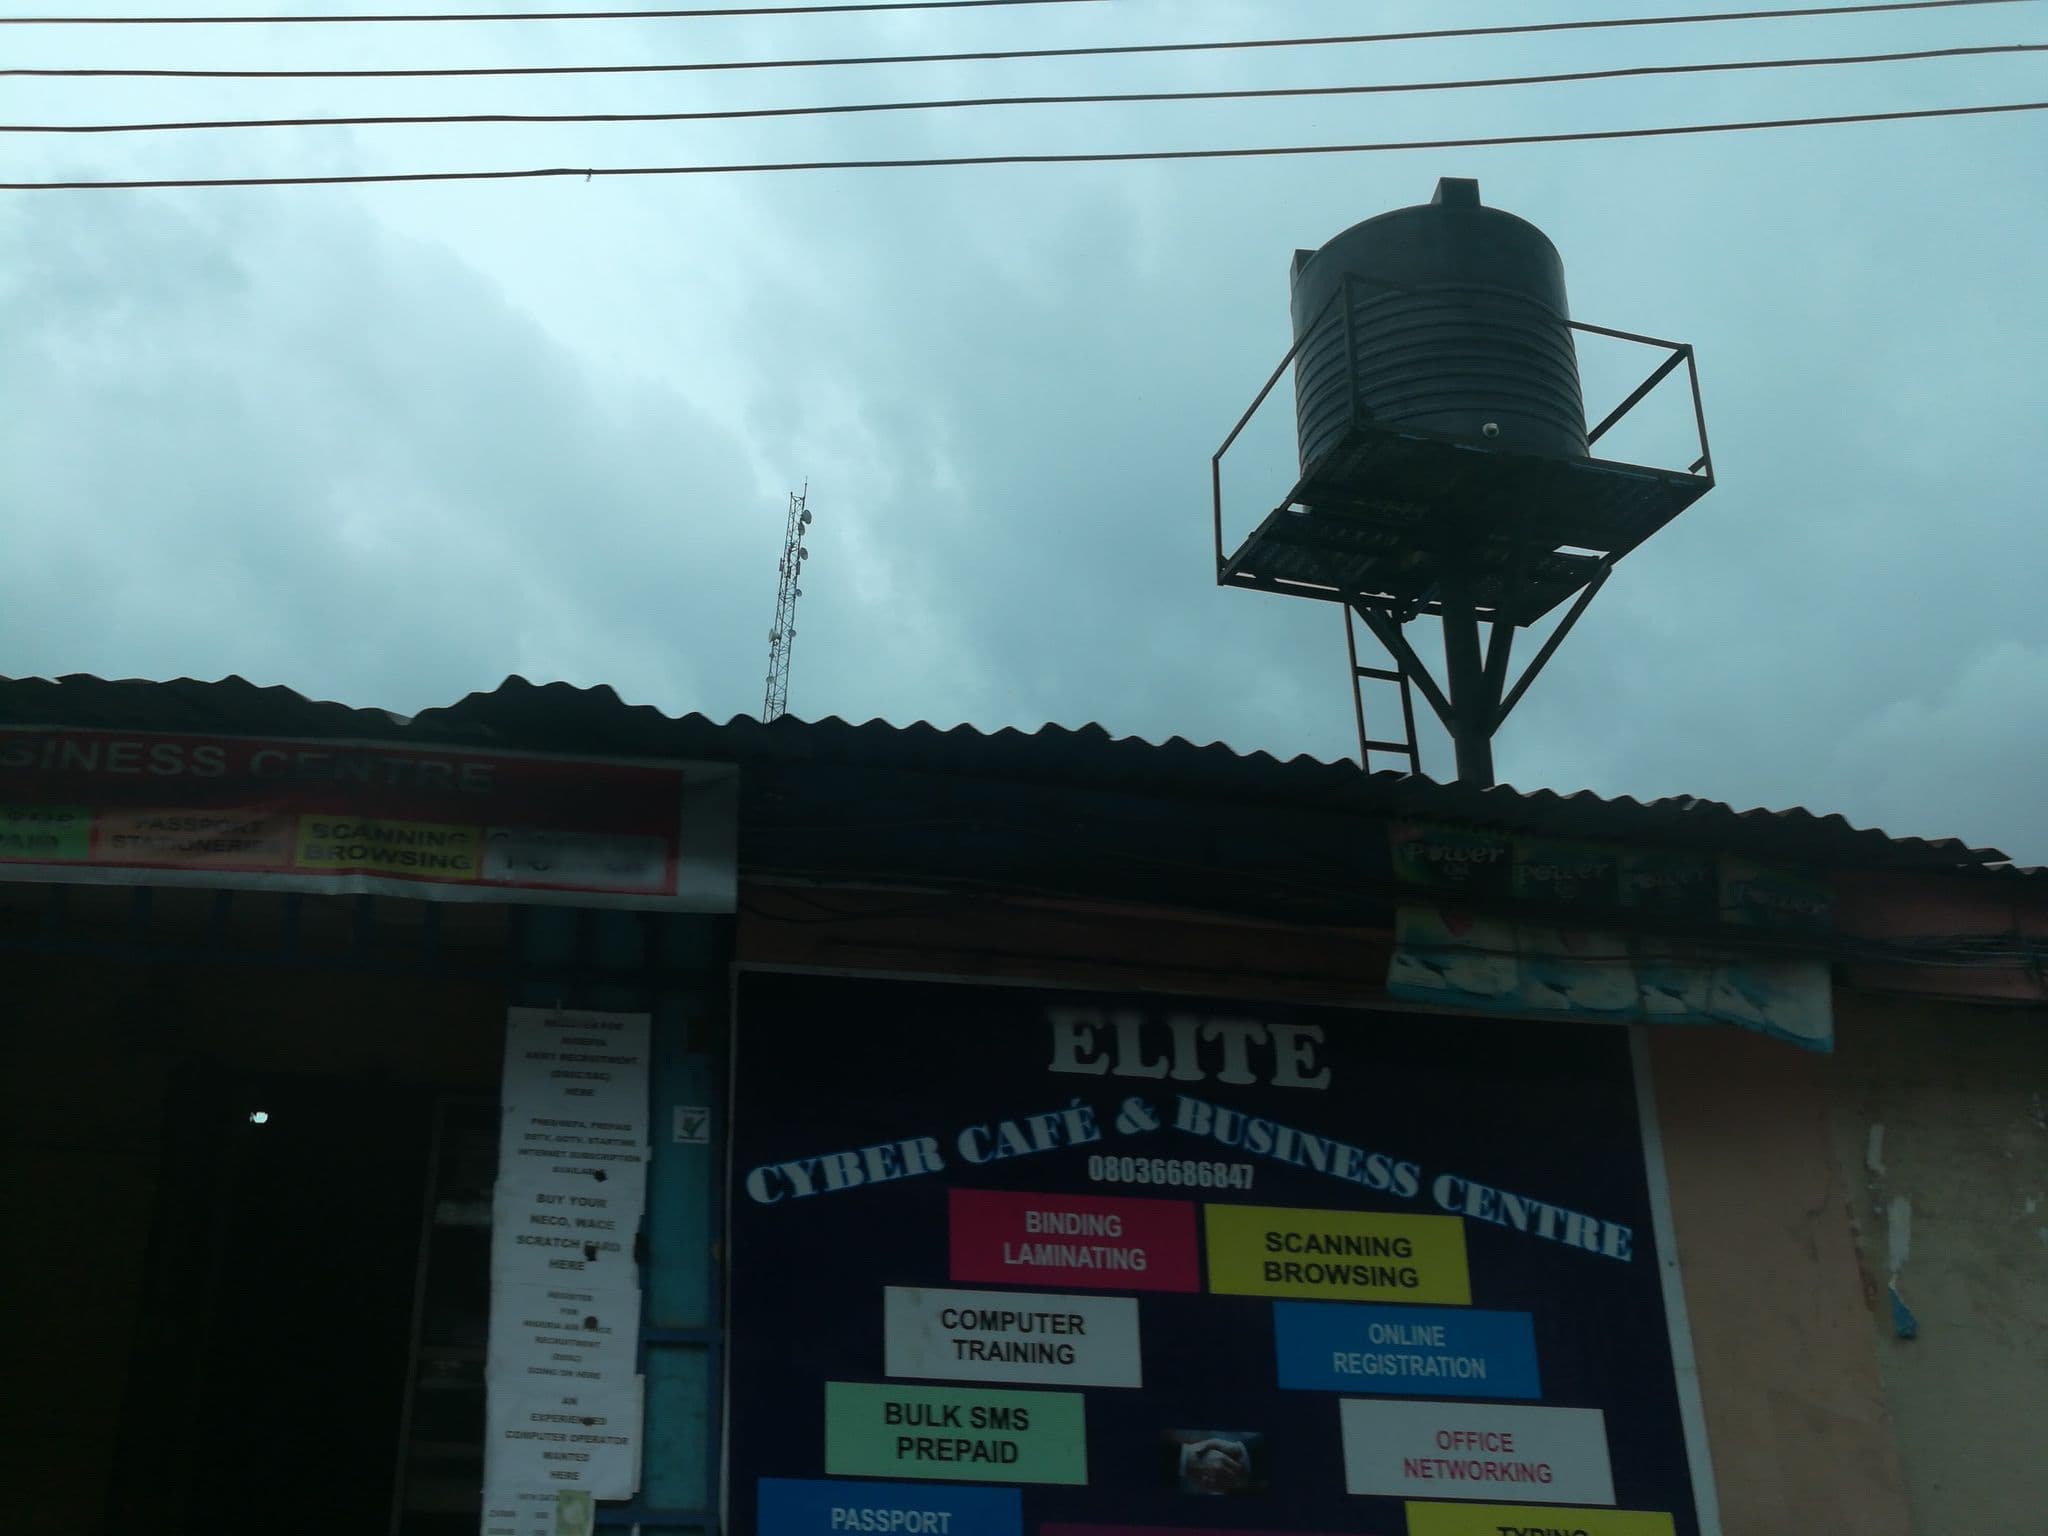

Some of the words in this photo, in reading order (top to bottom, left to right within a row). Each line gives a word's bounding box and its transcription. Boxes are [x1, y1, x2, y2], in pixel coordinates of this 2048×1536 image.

[311, 822, 470, 847] SCANNING
[304, 844, 474, 871] BROWSING
[1047, 1007, 1332, 1090] ELITE
[745, 1135, 947, 1206] CYBER
[956, 1096, 1102, 1165] CAFÉ
[1115, 1095, 1161, 1136] &
[1171, 1093, 1422, 1199] BUSINESS
[1432, 1171, 1634, 1264] CENTRE
[1088, 1154, 1255, 1190] 08036686847
[536, 1193, 566, 1204] BUY
[569, 1196, 608, 1208] YOUR
[1024, 1210, 1123, 1237] BINDING
[516, 1234, 580, 1249] SCRATCH
[1264, 1231, 1413, 1258] SCANNING
[549, 1259, 585, 1271] HERE
[1003, 1241, 1147, 1271] LAMINATING
[1263, 1260, 1419, 1288] BROWSING
[941, 1307, 1086, 1335] COMPUTER
[1367, 1322, 1447, 1349] ONLINE
[953, 1338, 1075, 1365] TRAINING
[1332, 1351, 1487, 1380] REGISTRATION
[884, 1402, 961, 1428] BULK
[970, 1405, 1030, 1431] SMS
[896, 1436, 1020, 1464] PREPAID
[1436, 1430, 1515, 1454] OFFICE
[550, 1470, 581, 1481] HERE
[1403, 1458, 1554, 1484] NETWORKING
[830, 1505, 953, 1536] PASSPORT
